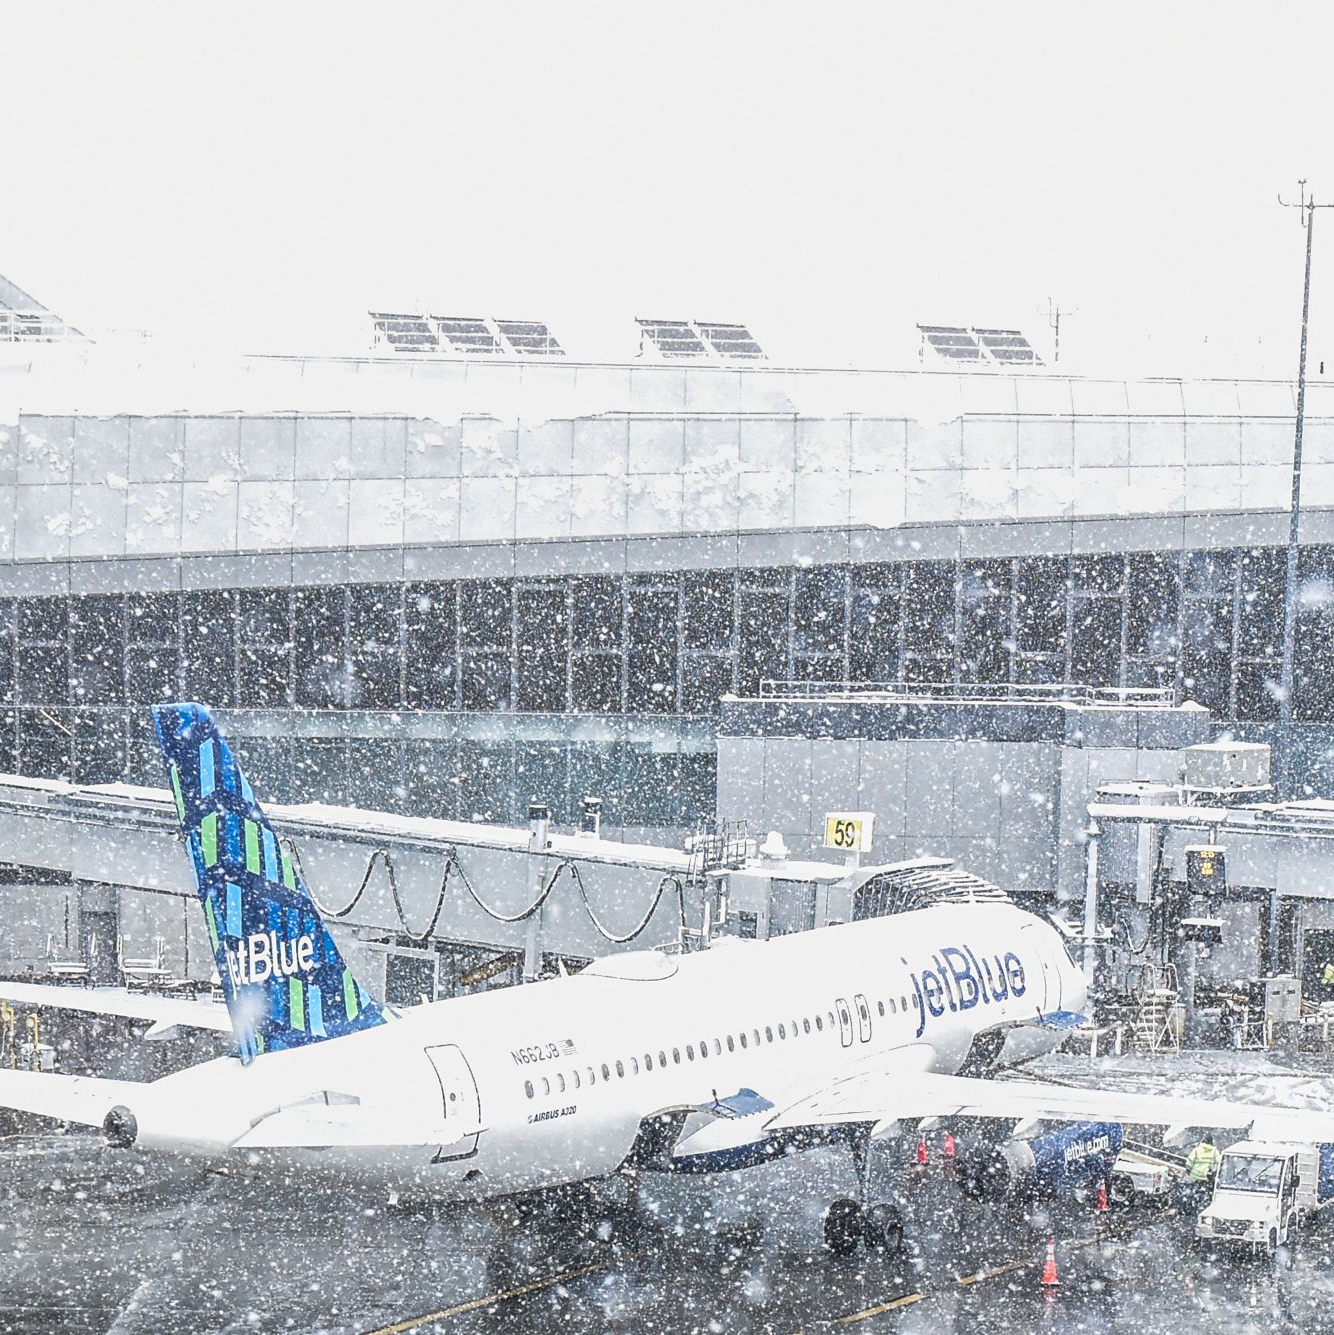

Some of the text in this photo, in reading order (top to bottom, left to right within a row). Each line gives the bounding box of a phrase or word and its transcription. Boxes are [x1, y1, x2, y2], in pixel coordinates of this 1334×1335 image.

[834, 820, 856, 848] 59
[900, 944, 1027, 1039] jetBlue
[510, 1042, 561, 1066] N662JB
[532, 1105, 578, 1123] AIRBUS A320
